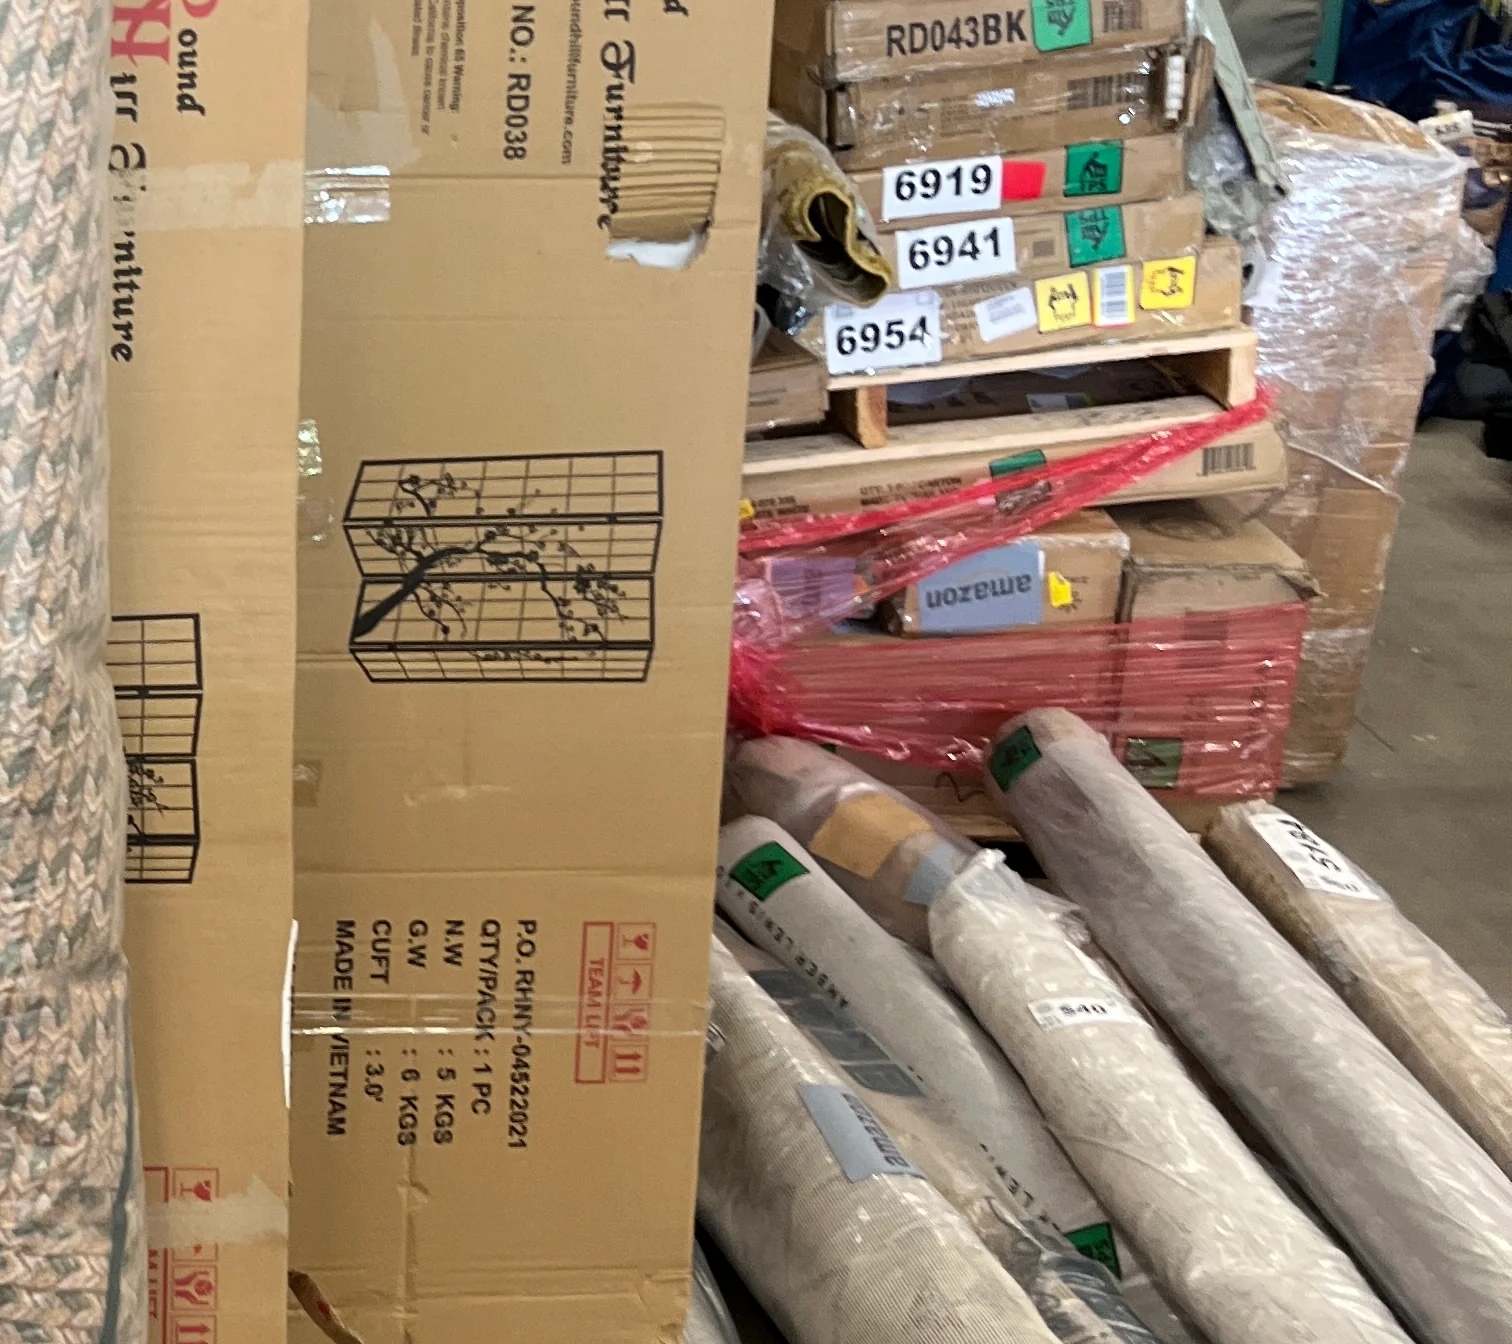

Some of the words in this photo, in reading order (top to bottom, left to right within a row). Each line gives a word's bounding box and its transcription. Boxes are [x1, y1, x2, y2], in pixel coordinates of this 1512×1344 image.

[509, 5, 535, 62] NO.:
[886, 9, 1027, 57] RD043BK
[503, 74, 531, 160] RD038
[895, 164, 992, 201] 6919
[108, 142, 146, 362] Fniture
[908, 226, 1001, 270] 6941
[837, 315, 929, 355] 6954
[926, 573, 1032, 609] amazon
[333, 919, 356, 991] MADE
[370, 919, 393, 985] CUFT
[407, 919, 429, 969] G.W
[443, 919, 465, 968] N.W
[516, 919, 537, 964] P.O.
[475, 919, 501, 1041] QTY/PACK
[586, 957, 605, 1007] TEAM
[331, 997, 352, 1020] IN
[401, 1068, 421, 1082] 6
[437, 1066, 456, 1081] 5
[473, 1063, 492, 1073] 1
[507, 969, 535, 1149] RHNY-04522021
[326, 1032, 350, 1136] VIETNAM
[471, 1083, 492, 1116] PC
[397, 1095, 419, 1147] KGS
[433, 1094, 456, 1145] KGS
